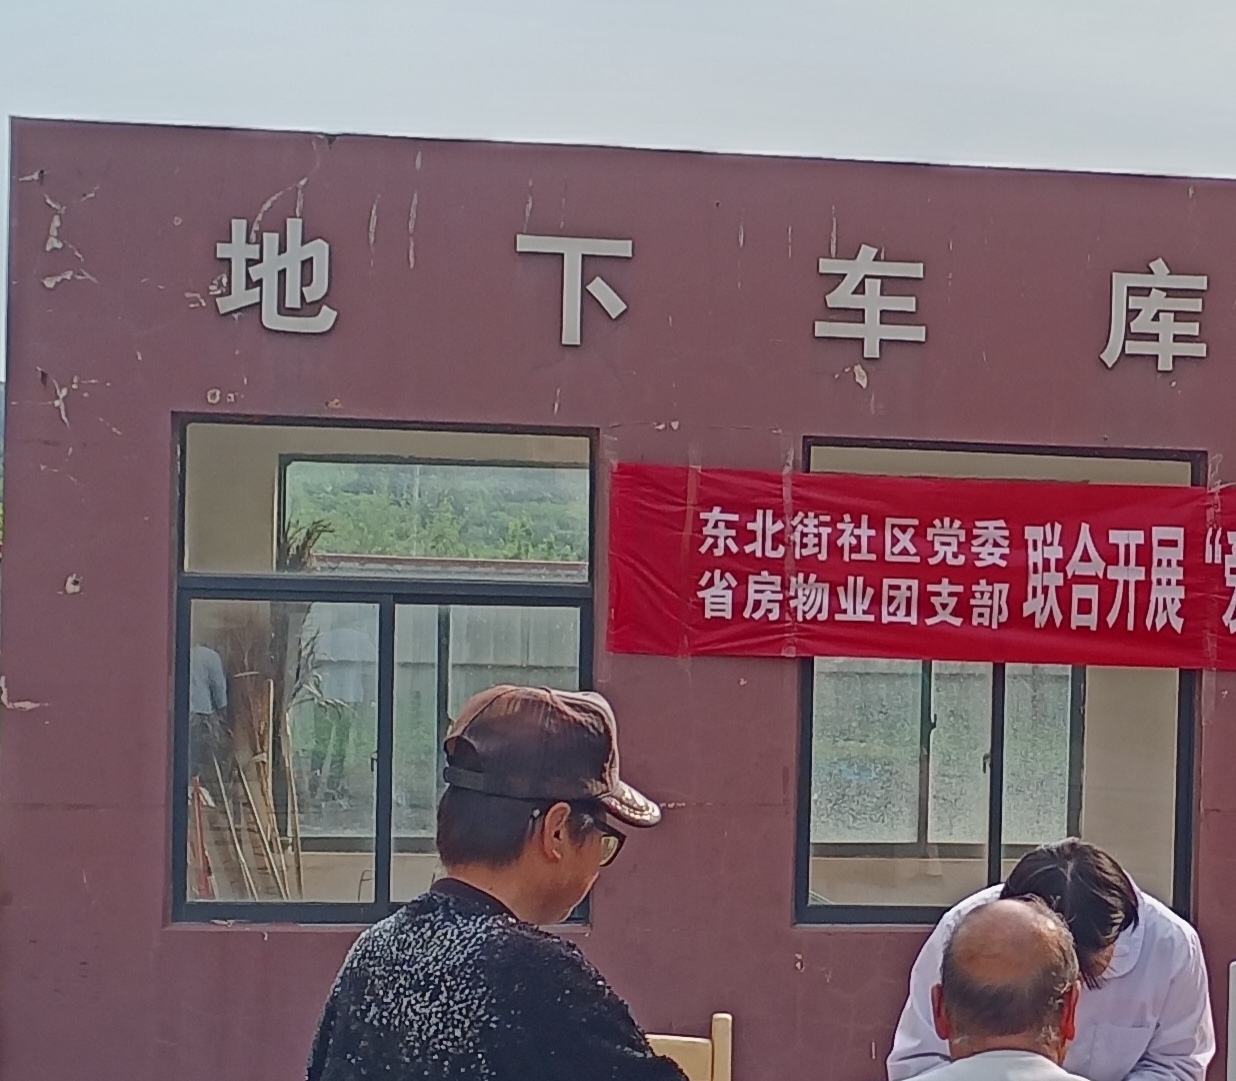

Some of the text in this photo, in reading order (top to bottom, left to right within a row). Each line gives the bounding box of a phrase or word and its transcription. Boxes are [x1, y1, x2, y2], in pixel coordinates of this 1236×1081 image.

[698, 506, 1010, 568] 东北街社区党委
[696, 569, 1010, 629] 省房物业团支部
